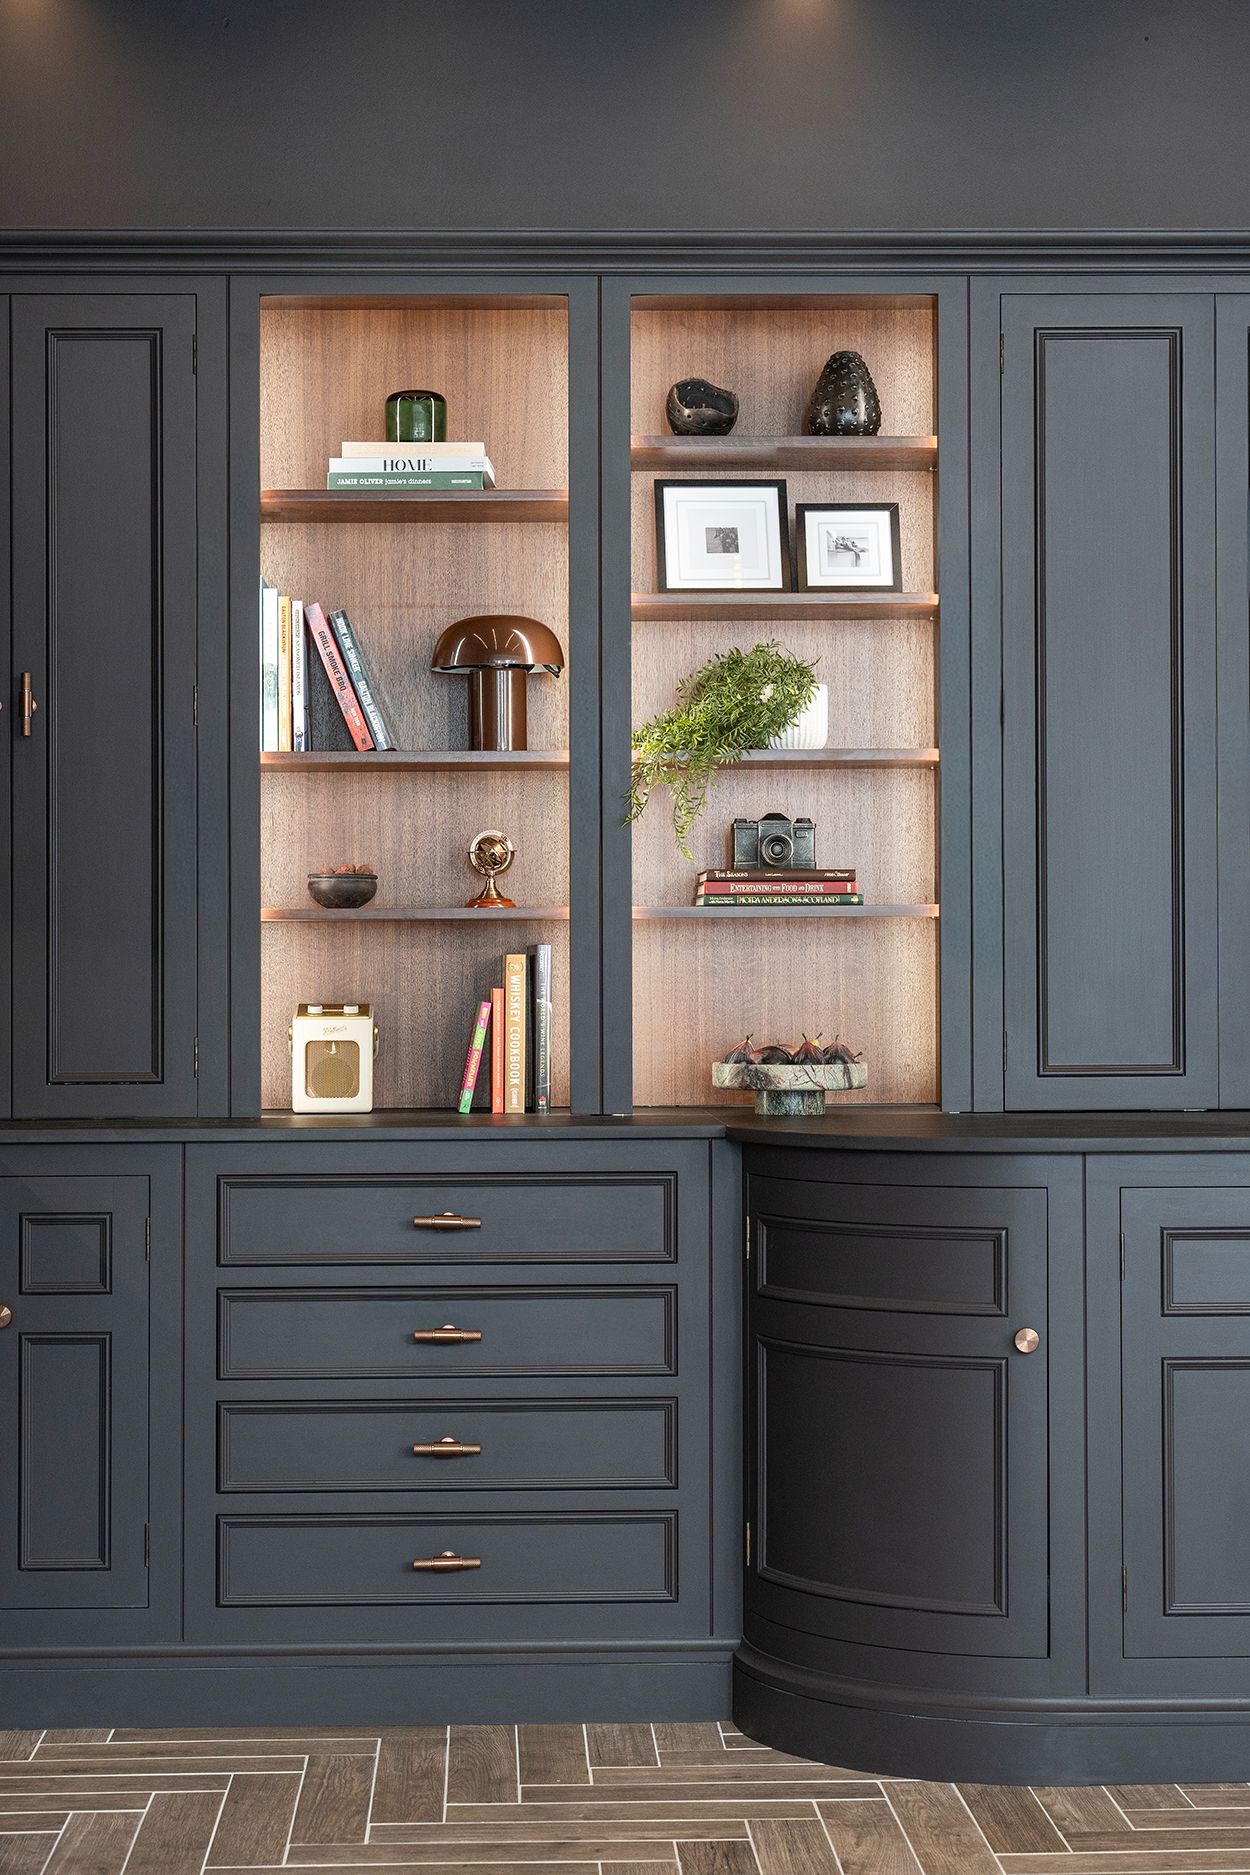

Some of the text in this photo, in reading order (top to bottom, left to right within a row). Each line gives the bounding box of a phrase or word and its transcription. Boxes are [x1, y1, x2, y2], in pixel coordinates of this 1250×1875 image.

[382, 459, 433, 472] HOME
[384, 477, 407, 486] jamie's
[407, 477, 432, 485] dinners
[318, 630, 347, 692] GRILL SMOKE BBQ
[335, 617, 361, 674] HOOK LINE SINKER
[357, 680, 386, 744] GALTON BLACKISTON
[730, 883, 772, 893] ENTERTAINING
[781, 883, 798, 893] FOOD
[805, 883, 824, 893] DRINK
[739, 895, 761, 904] MOIRA
[803, 895, 840, 904] SCOTLAND
[510, 974, 522, 1028] WHISKEY
[509, 1028, 522, 1086] COOKBOOK
